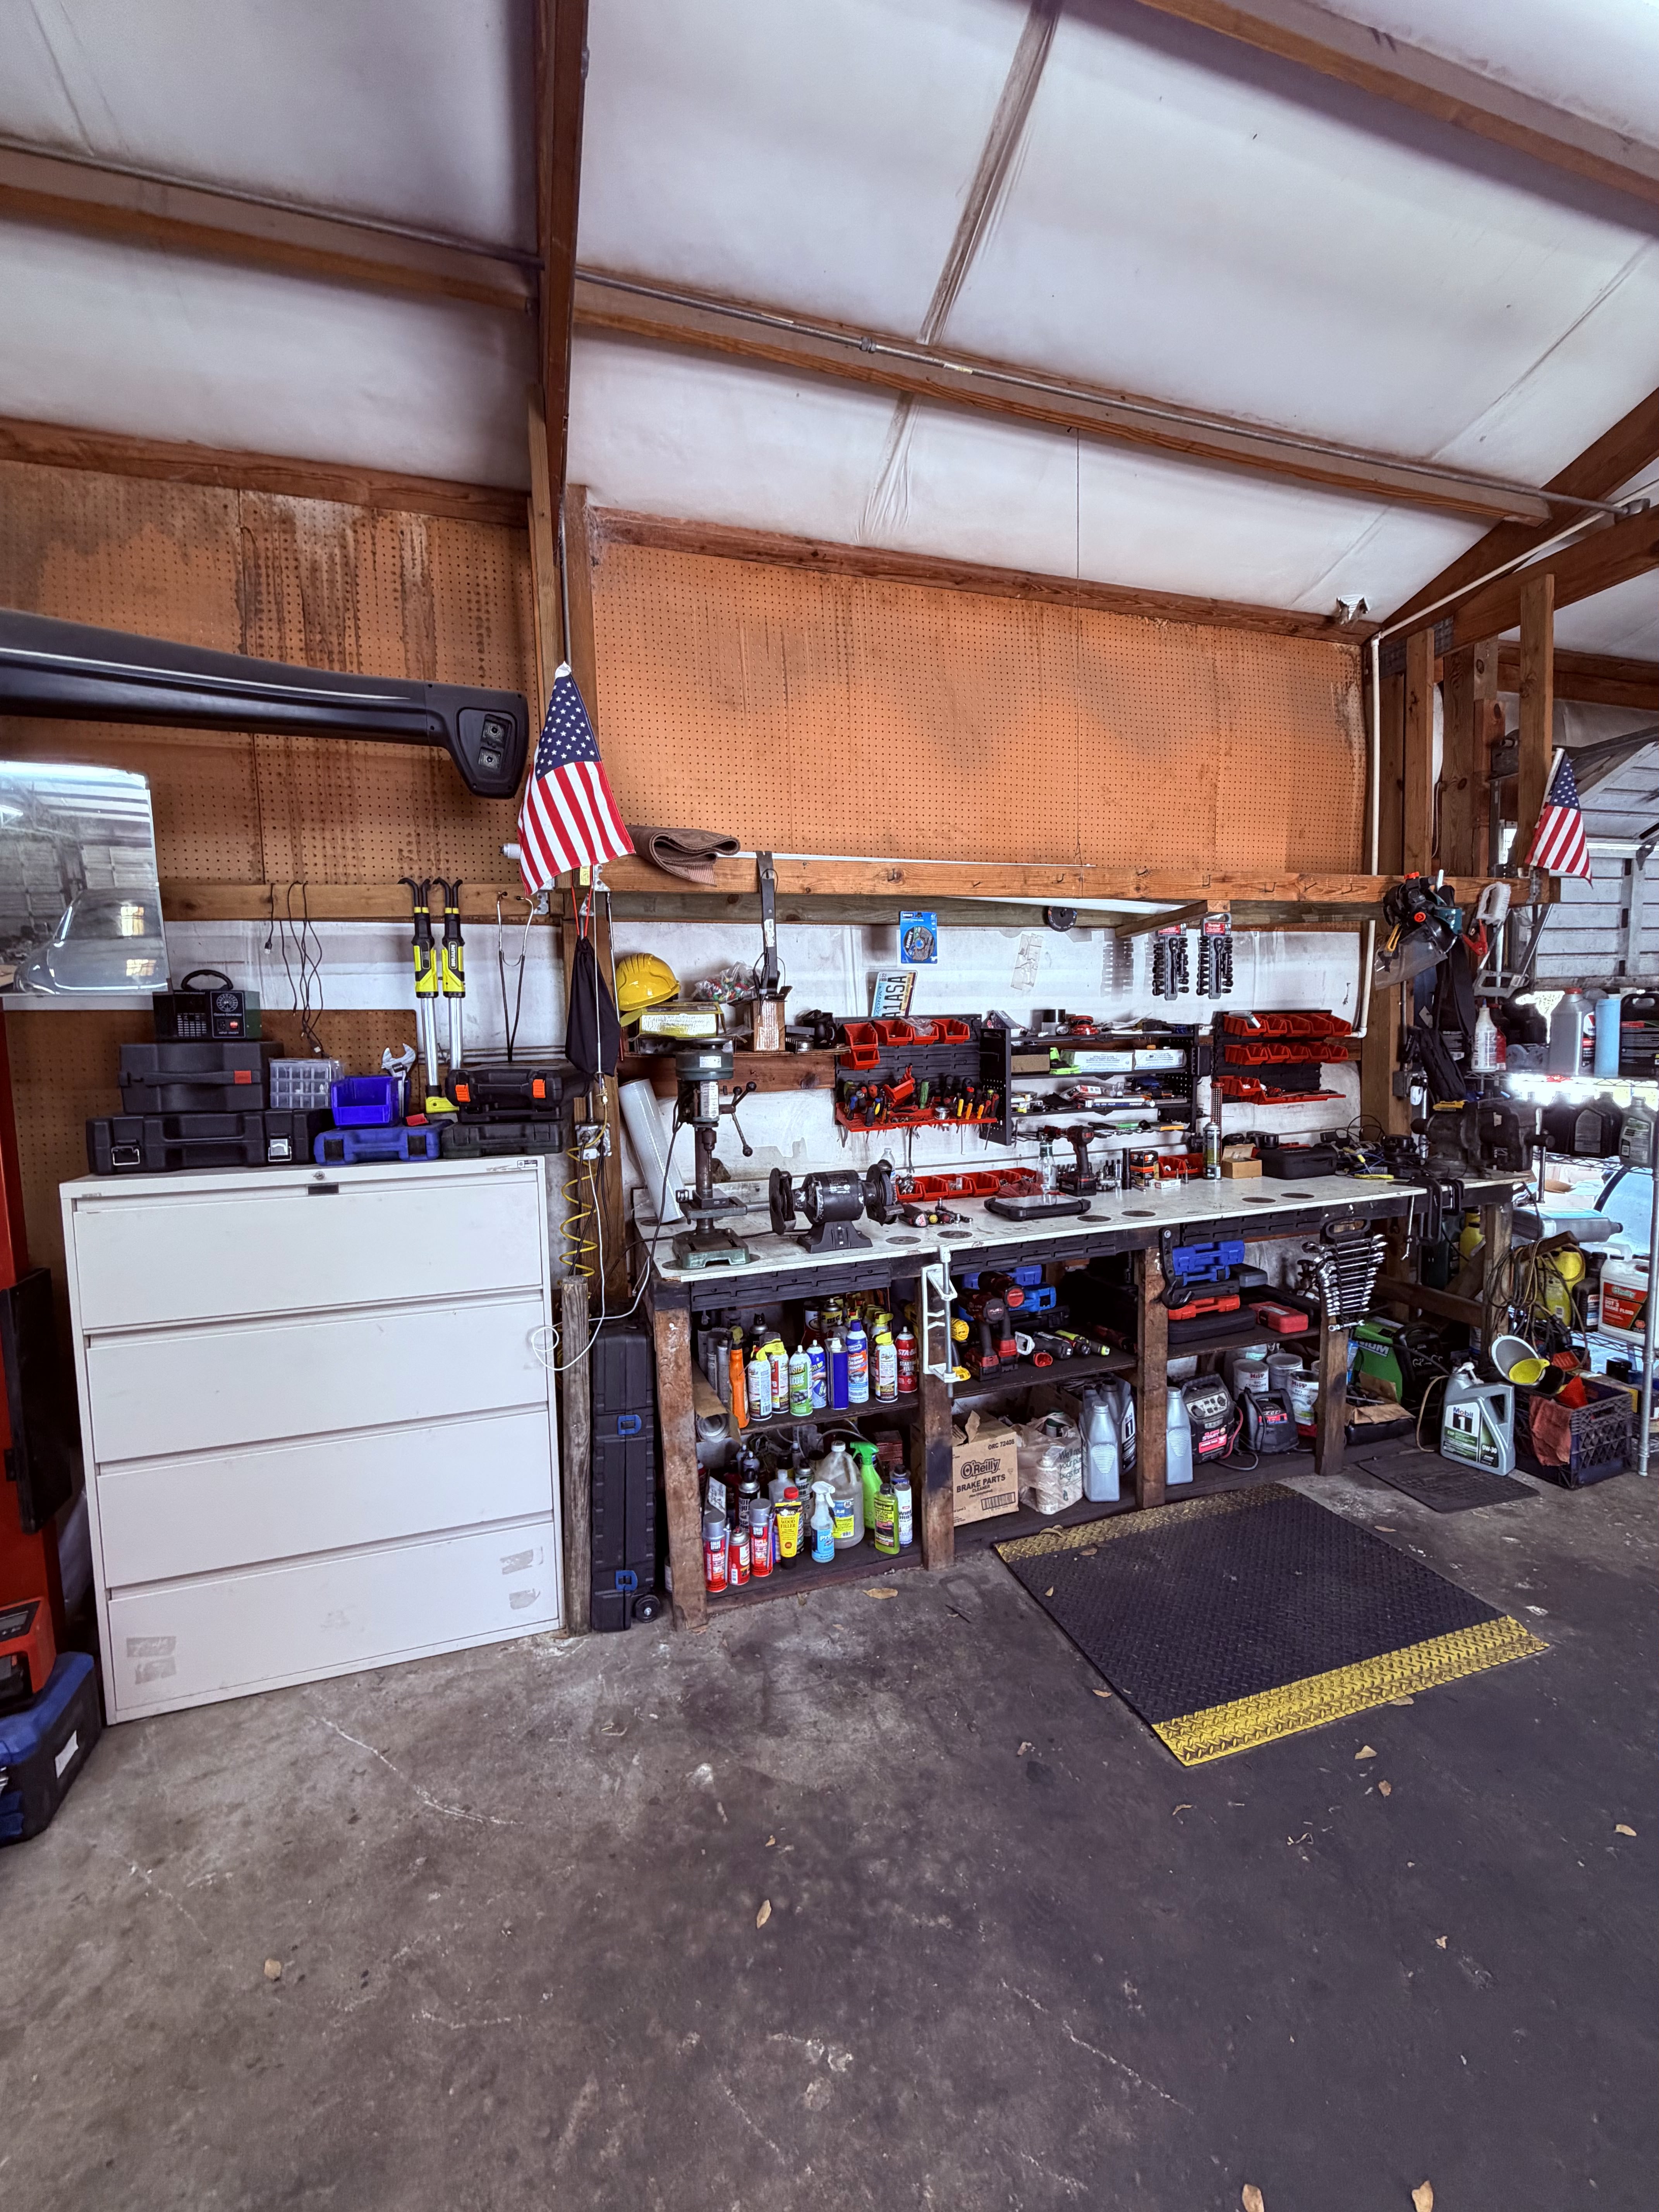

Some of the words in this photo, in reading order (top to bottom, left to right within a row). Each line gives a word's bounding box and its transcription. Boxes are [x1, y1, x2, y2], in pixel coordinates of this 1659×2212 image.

[1291, 1380, 1307, 1388] HiPP
[1453, 1407, 1474, 1418] Mobil
[1127, 1422, 1131, 1436] 1
[1458, 1416, 1465, 1431] 1
[1202, 1432, 1219, 1441] START
[1000, 1439, 1015, 1448] 72408
[1482, 1444, 1498, 1454] 0W-30
[962, 1459, 1000, 1479] O'Reilly
[1059, 1460, 1073, 1471] your
[956, 1480, 981, 1493] BRAKE
[982, 1474, 1006, 1486] PARTS
[972, 1484, 991, 1493] CLEANER
